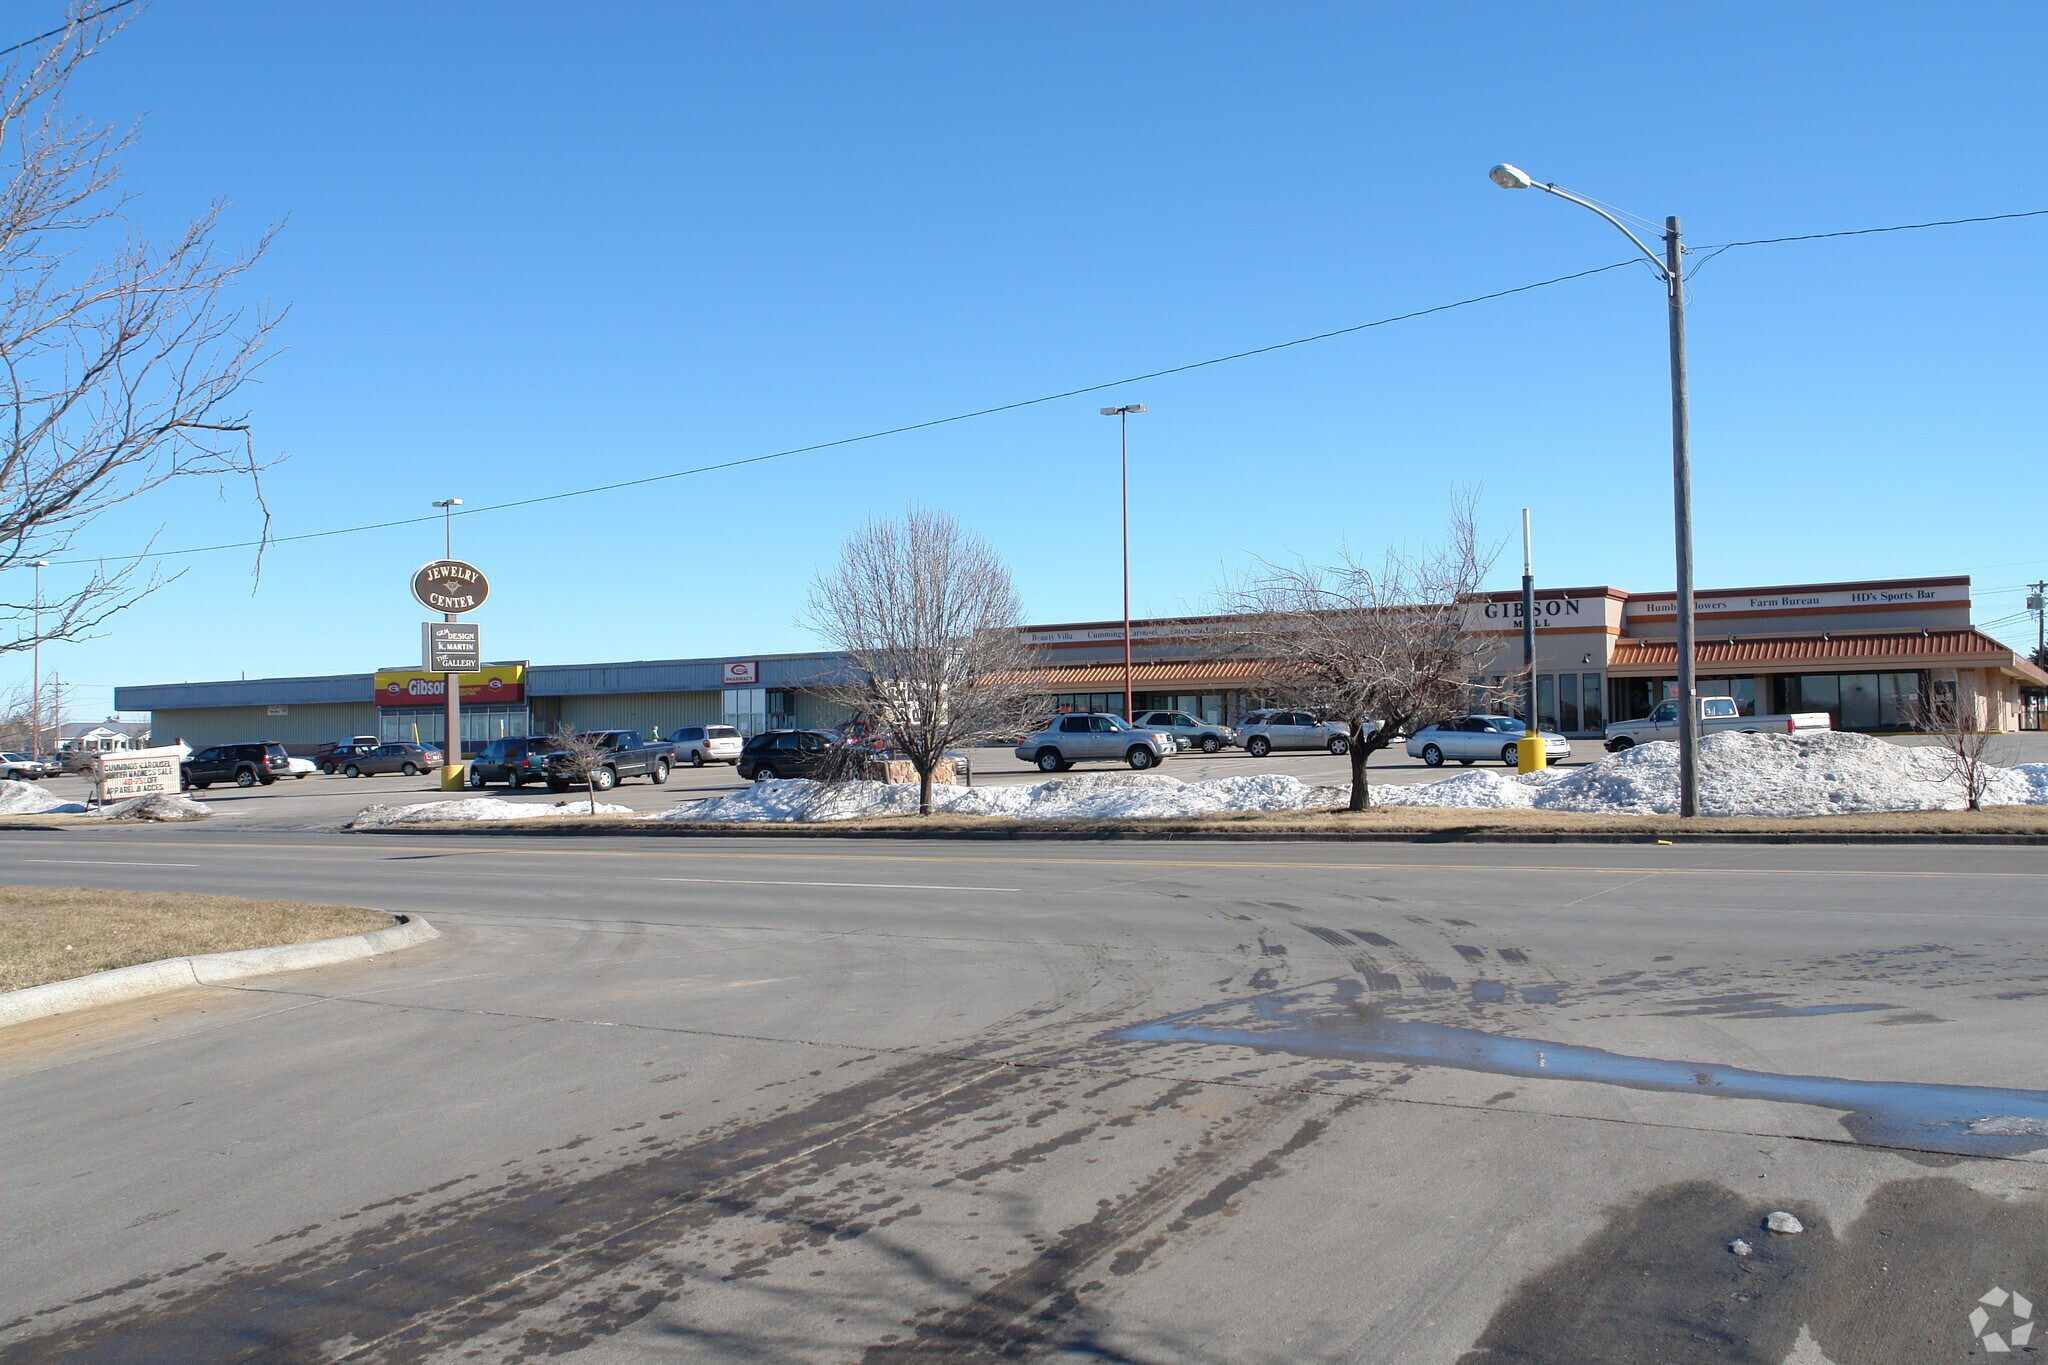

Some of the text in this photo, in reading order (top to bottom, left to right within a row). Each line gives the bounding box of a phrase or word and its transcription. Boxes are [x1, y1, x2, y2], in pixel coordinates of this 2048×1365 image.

[427, 566, 478, 583] JEWELRY
[429, 593, 475, 608] CENTER
[1851, 590, 1936, 602] HD's Sports Bar
[1646, 601, 1728, 613] Humb lowers
[1750, 597, 1820, 607] Farm Bureau
[1484, 600, 1580, 619] GIBSON
[1513, 619, 1551, 628] MLL
[1057, 632, 1073, 640] Villa
[1087, 630, 1125, 640] Cummings
[442, 659, 476, 667] GALLERY
[104, 763, 137, 771] CUMMINGS
[158, 767, 173, 776] SALE
[106, 786, 134, 794] APPAREL
